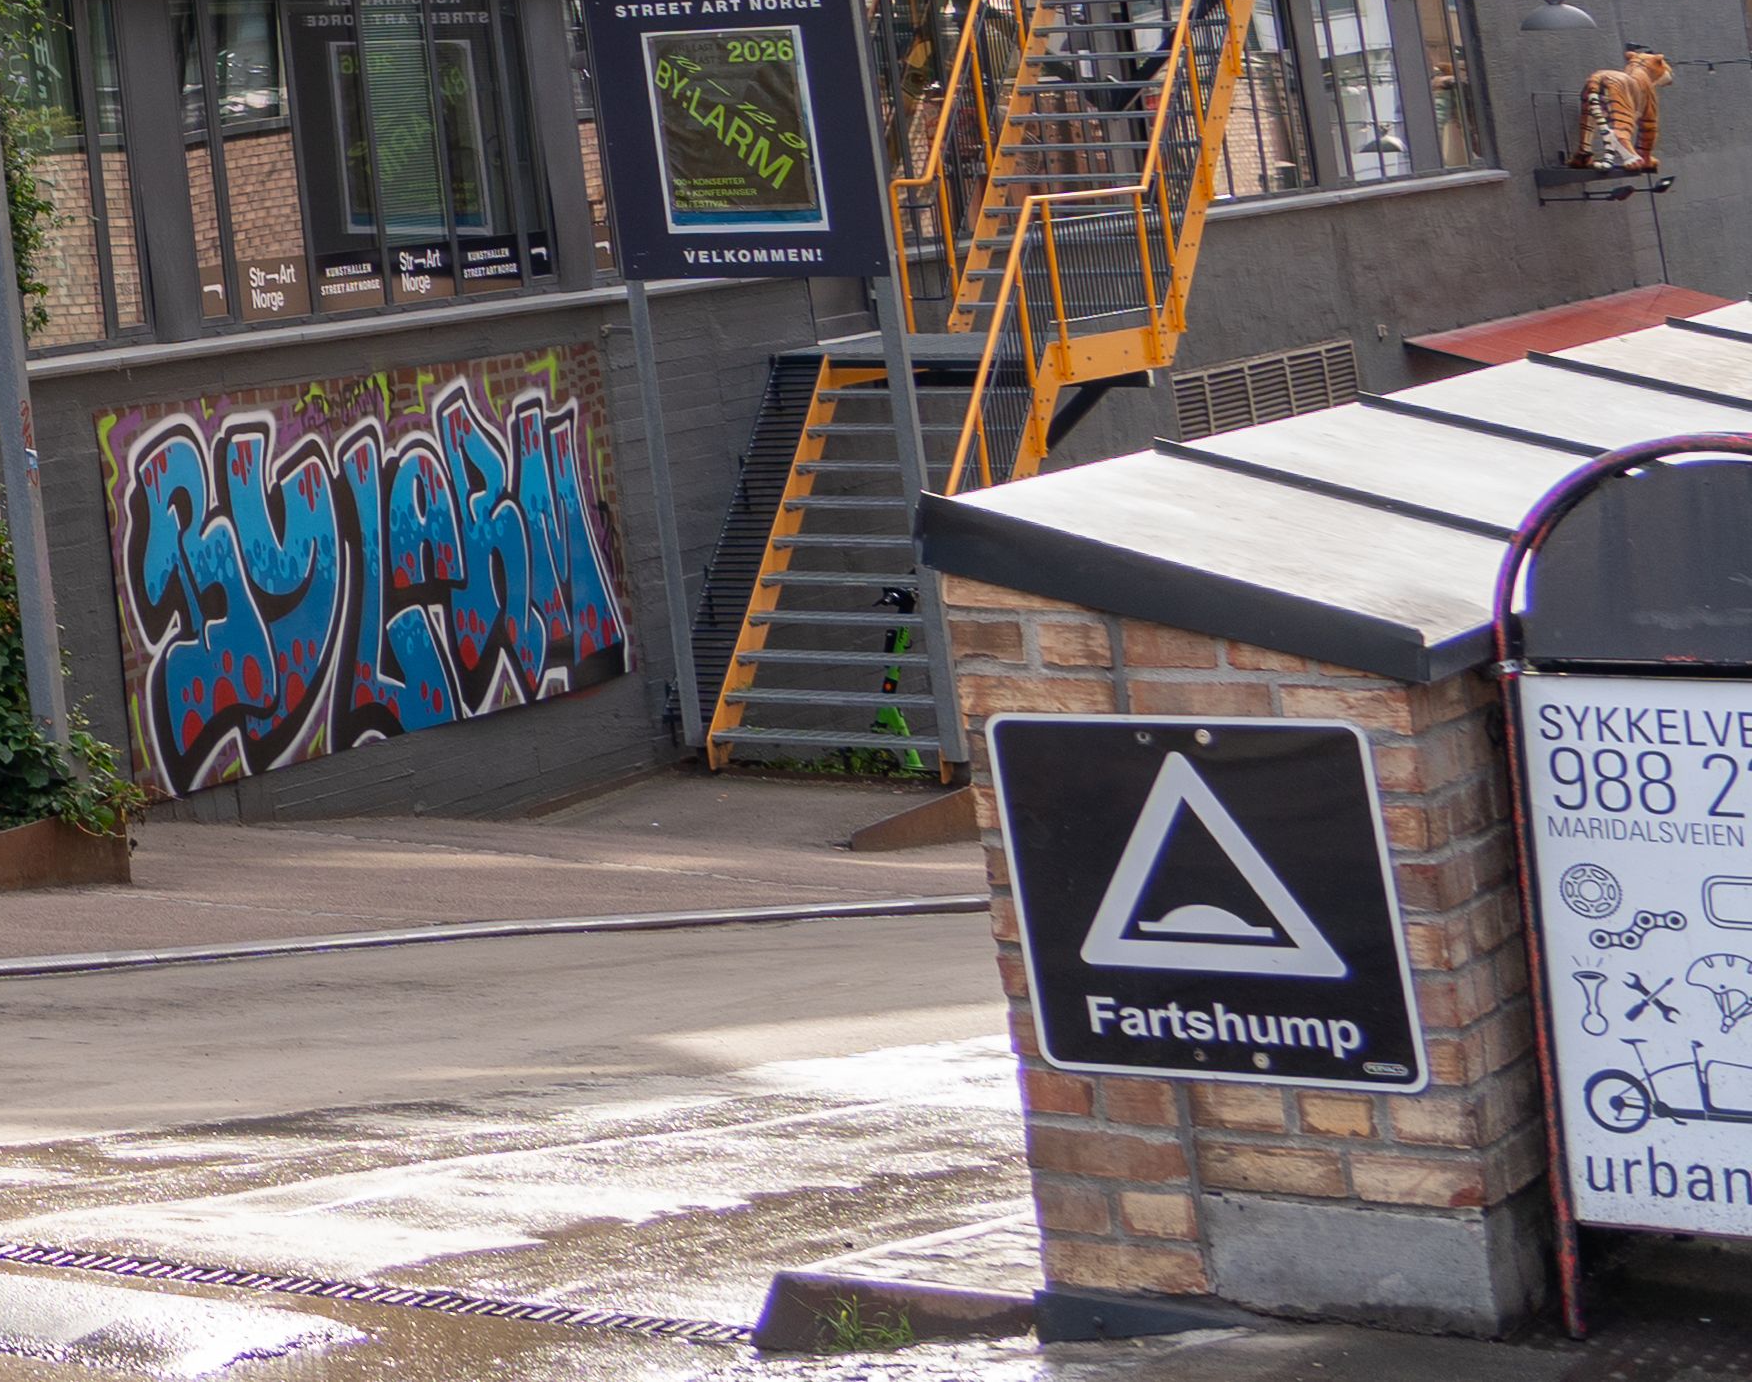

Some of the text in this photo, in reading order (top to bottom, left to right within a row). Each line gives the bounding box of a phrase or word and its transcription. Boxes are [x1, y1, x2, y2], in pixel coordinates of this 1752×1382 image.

[615, 2, 692, 18] STREET
[701, 0, 741, 13] ART
[727, 41, 794, 62] 2026
[655, 59, 794, 189] BY:LARM
[467, 247, 510, 261] KUNSTHALLEN
[683, 249, 823, 264] VELKOMMEN!
[325, 263, 372, 277] KUNSTHALLEN
[463, 267, 486, 279] STREET
[499, 262, 518, 274] NORGE
[321, 284, 344, 296] STREET
[358, 279, 381, 290] NORGE
[401, 273, 431, 294] Norge
[251, 288, 285, 311] Norge
[1548, 747, 1752, 818] 988 2
[1547, 815, 1745, 847] MARIDALSVEIEN
[1087, 994, 1362, 1057] Fartshump
